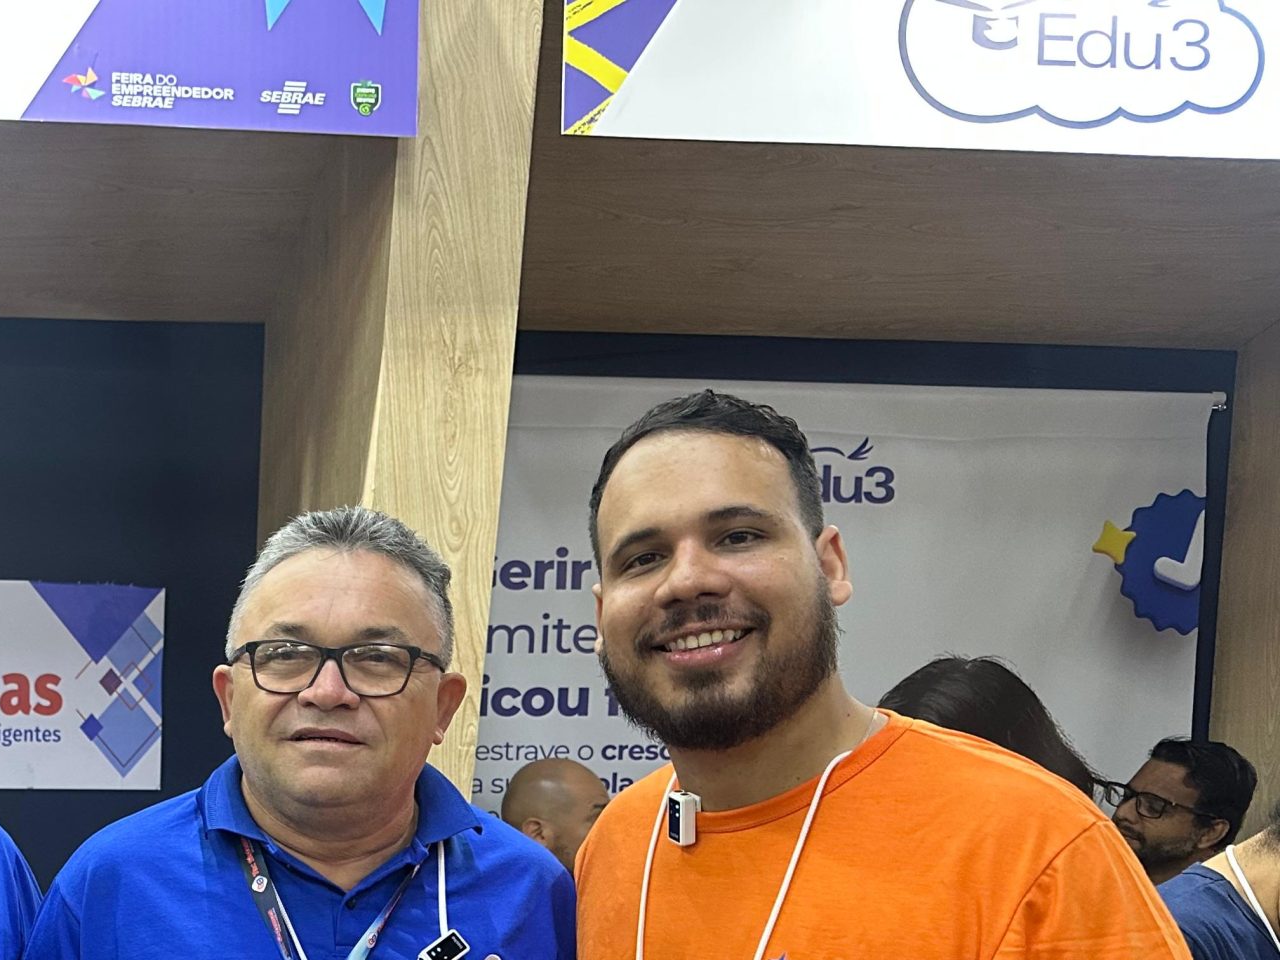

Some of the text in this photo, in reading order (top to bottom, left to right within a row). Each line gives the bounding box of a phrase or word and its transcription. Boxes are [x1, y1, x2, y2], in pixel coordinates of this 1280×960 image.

[1037, 13, 1210, 71] Edu3
[112, 72, 177, 87] FEIRA DO
[112, 84, 234, 101] EMPREENDEDOR
[260, 90, 325, 106] SEBRAE
[112, 96, 174, 109] SEBRAE
[578, 745, 593, 760] o
